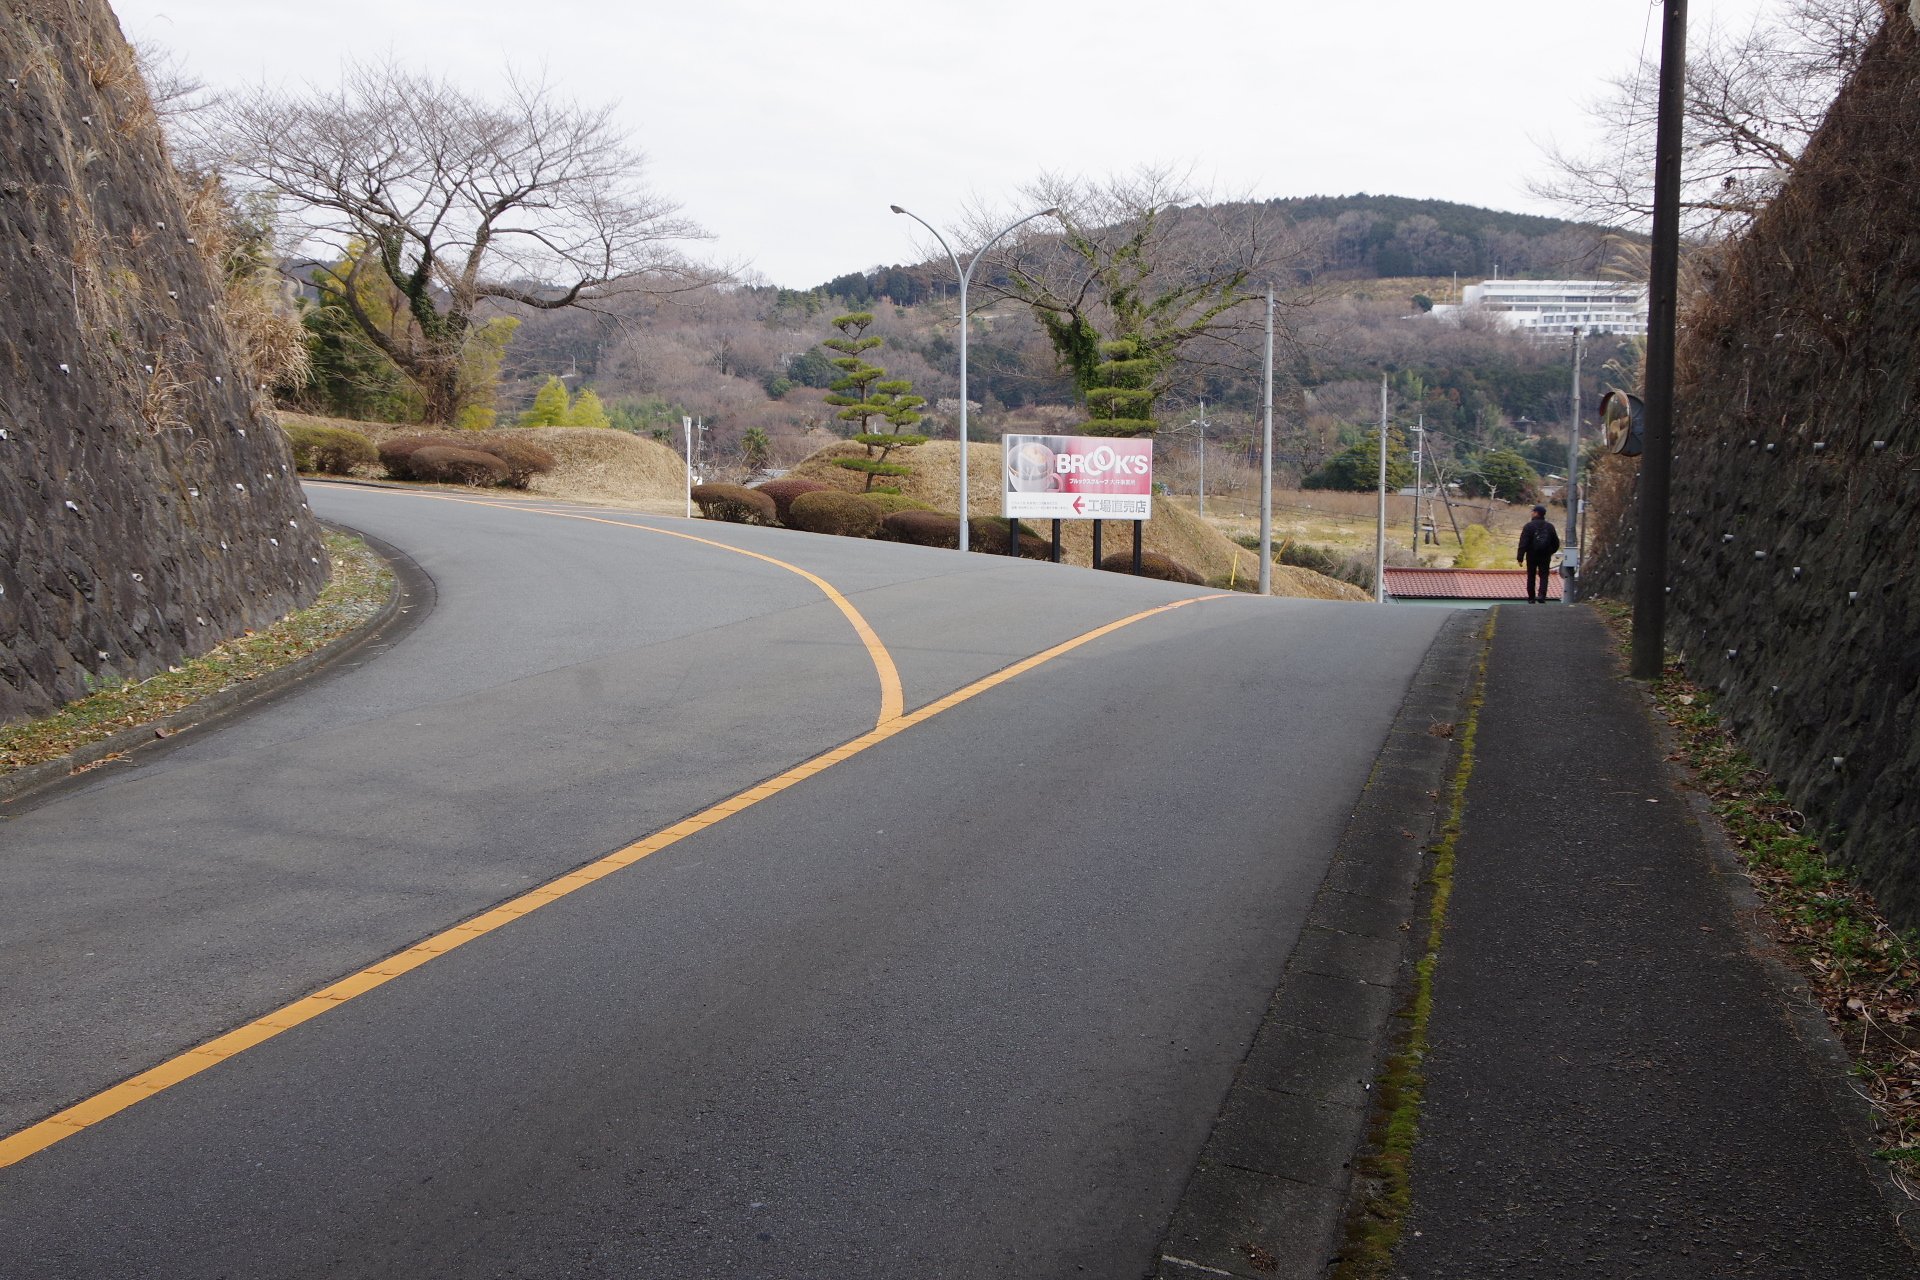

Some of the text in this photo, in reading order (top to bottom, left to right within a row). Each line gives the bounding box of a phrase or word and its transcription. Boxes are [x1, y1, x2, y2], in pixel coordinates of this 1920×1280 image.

[1057, 446, 1148, 476] BROOK'S
[1088, 499, 1147, 514] 工場直売店
